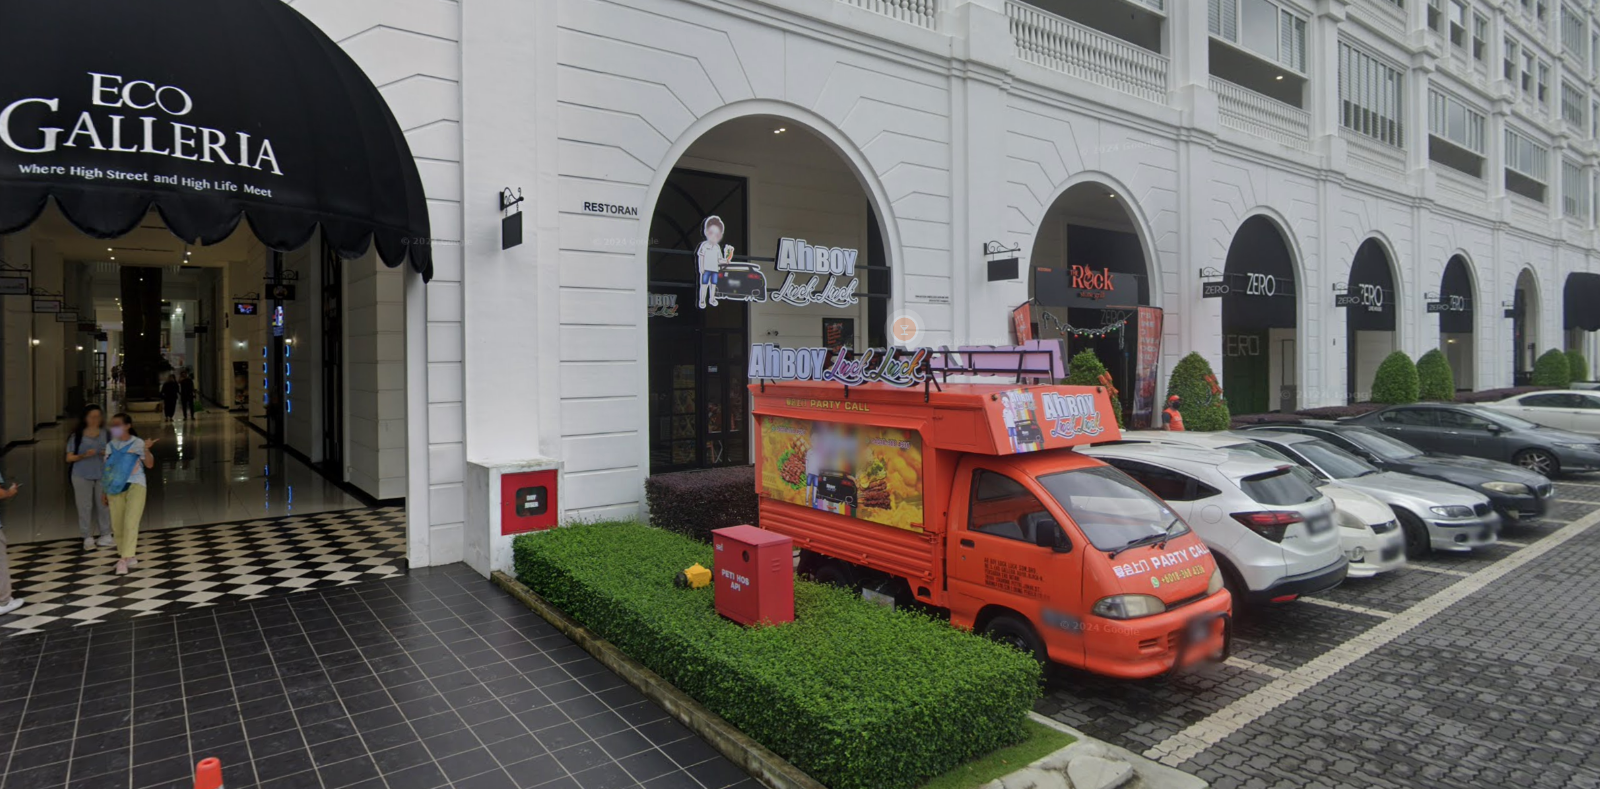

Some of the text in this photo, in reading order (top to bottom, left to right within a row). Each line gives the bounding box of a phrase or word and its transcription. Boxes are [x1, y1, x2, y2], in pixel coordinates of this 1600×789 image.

[87, 71, 193, 116] ECO
[0, 97, 284, 176] GALLERIA
[18, 163, 273, 198] Where High Street and High Life Meet
[583, 201, 638, 216] RESTORAN
[775, 237, 858, 277] AhBOY
[771, 272, 859, 309] Luck Luck
[1205, 284, 1230, 295] ZERO
[1246, 271, 1276, 297] ZERO
[1337, 296, 1361, 305] ZERO
[1428, 303, 1449, 311] ZERO
[1100, 309, 1125, 326] ZERO
[748, 343, 927, 388] AhBOY Luck Luck
[810, 399, 841, 409] PARTY
[844, 401, 870, 412] CALL
[1041, 392, 1096, 421] AhBOY
[1150, 549, 1189, 570] PARTY
[1188, 542, 1211, 559] CALL
[721, 568, 750, 586] PETI HOS
[730, 581, 741, 592] API
